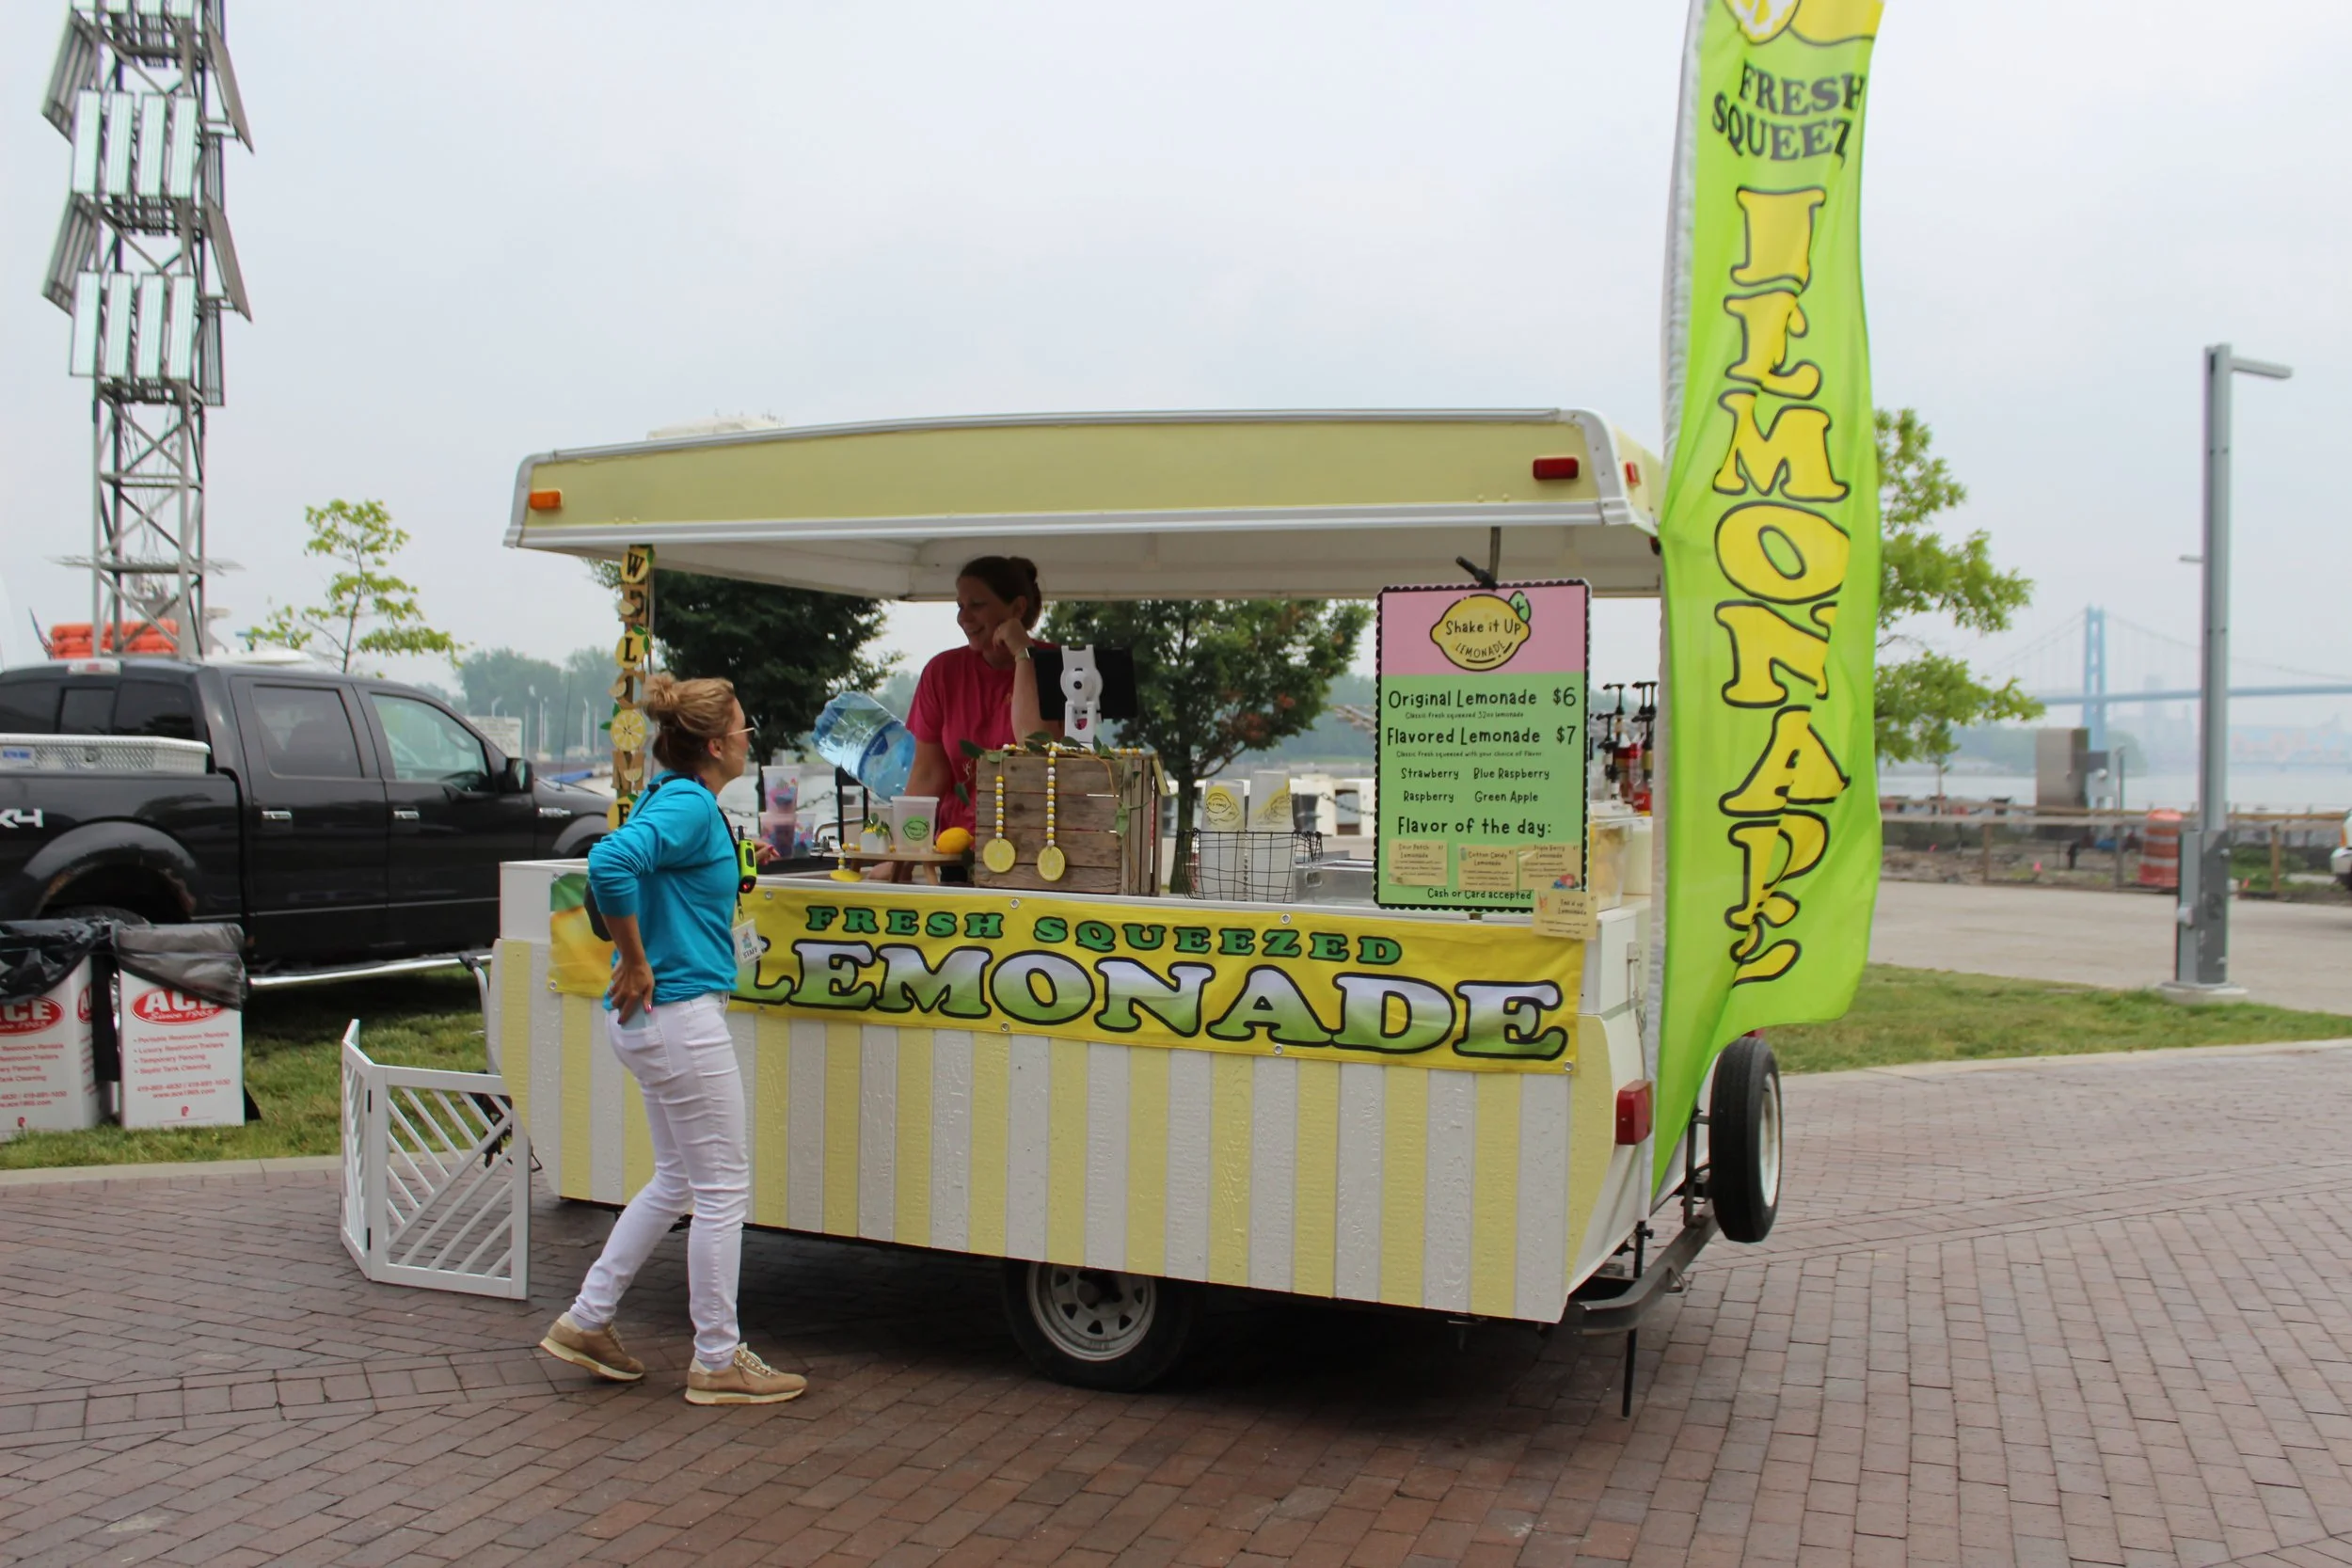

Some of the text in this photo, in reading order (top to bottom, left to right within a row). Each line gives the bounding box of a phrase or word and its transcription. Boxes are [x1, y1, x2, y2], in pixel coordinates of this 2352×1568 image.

[1738, 58, 1866, 116] FRESH
[1445, 618, 1521, 636] Shake it Up
[1454, 641, 1505, 658] LEMONADE
[1388, 687, 1577, 709] Original Lemonade $6
[1494, 710, 1524, 719] lemonade
[1387, 725, 1577, 746] Flavored Lemonade $7
[1400, 767, 1460, 781] Strawberry
[1473, 767, 1550, 782] Blue Raspberry
[1403, 790, 1454, 804] Raspberry
[1474, 790, 1539, 804] Green Apple
[1397, 816, 1552, 839] Flavor of the day:
[1427, 887, 1533, 901] Cash or Card accepted
[805, 906, 1403, 965] FRESH SQUEEZED
[0, 999, 52, 1021] CE
